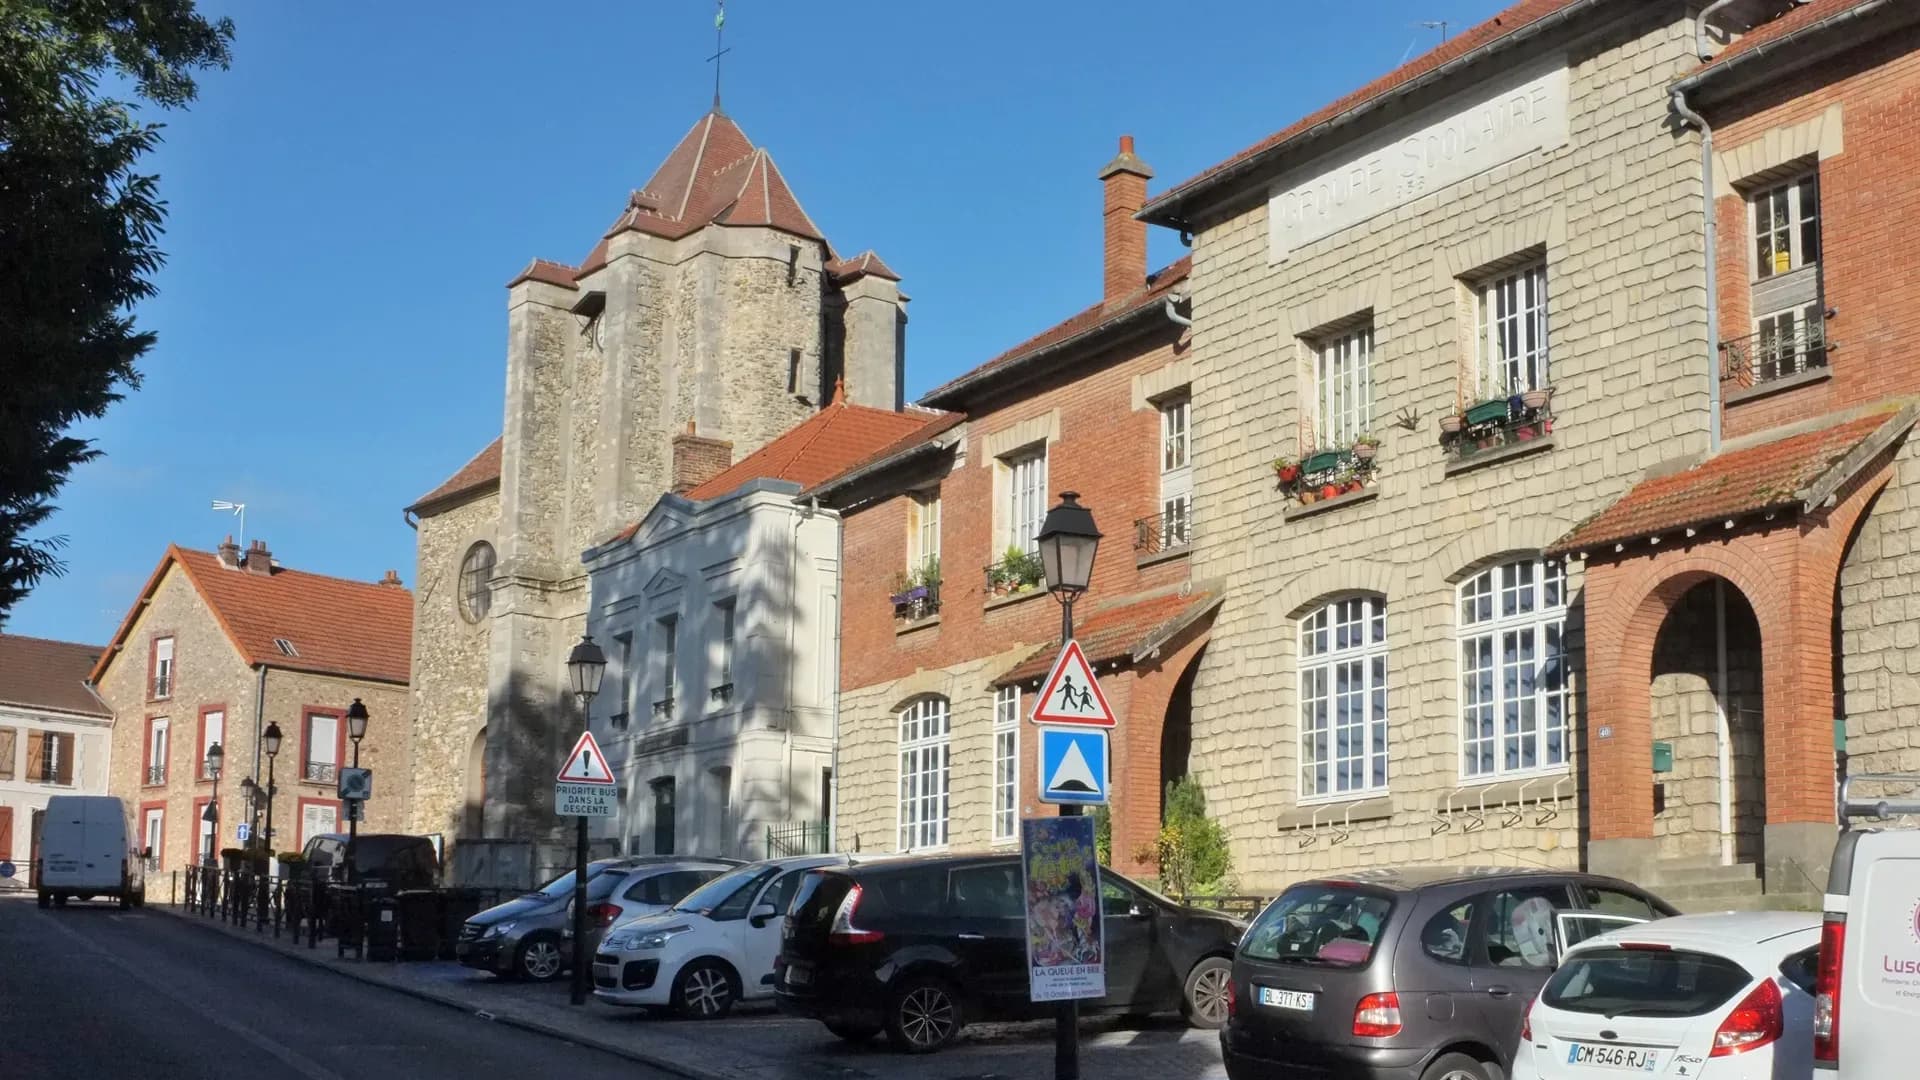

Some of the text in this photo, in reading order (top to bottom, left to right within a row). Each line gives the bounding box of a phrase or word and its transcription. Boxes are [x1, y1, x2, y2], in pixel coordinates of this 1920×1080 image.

[1281, 85, 1548, 230] GROUPE SCOLAIRE
[556, 785, 617, 797] PRIORITE BUS
[568, 795, 605, 805] DANS LA
[563, 804, 609, 815] DESCENTE
[1035, 968, 1046, 976] LA
[1047, 967, 1075, 976] QUEUE
[1075, 967, 1086, 975] EN
